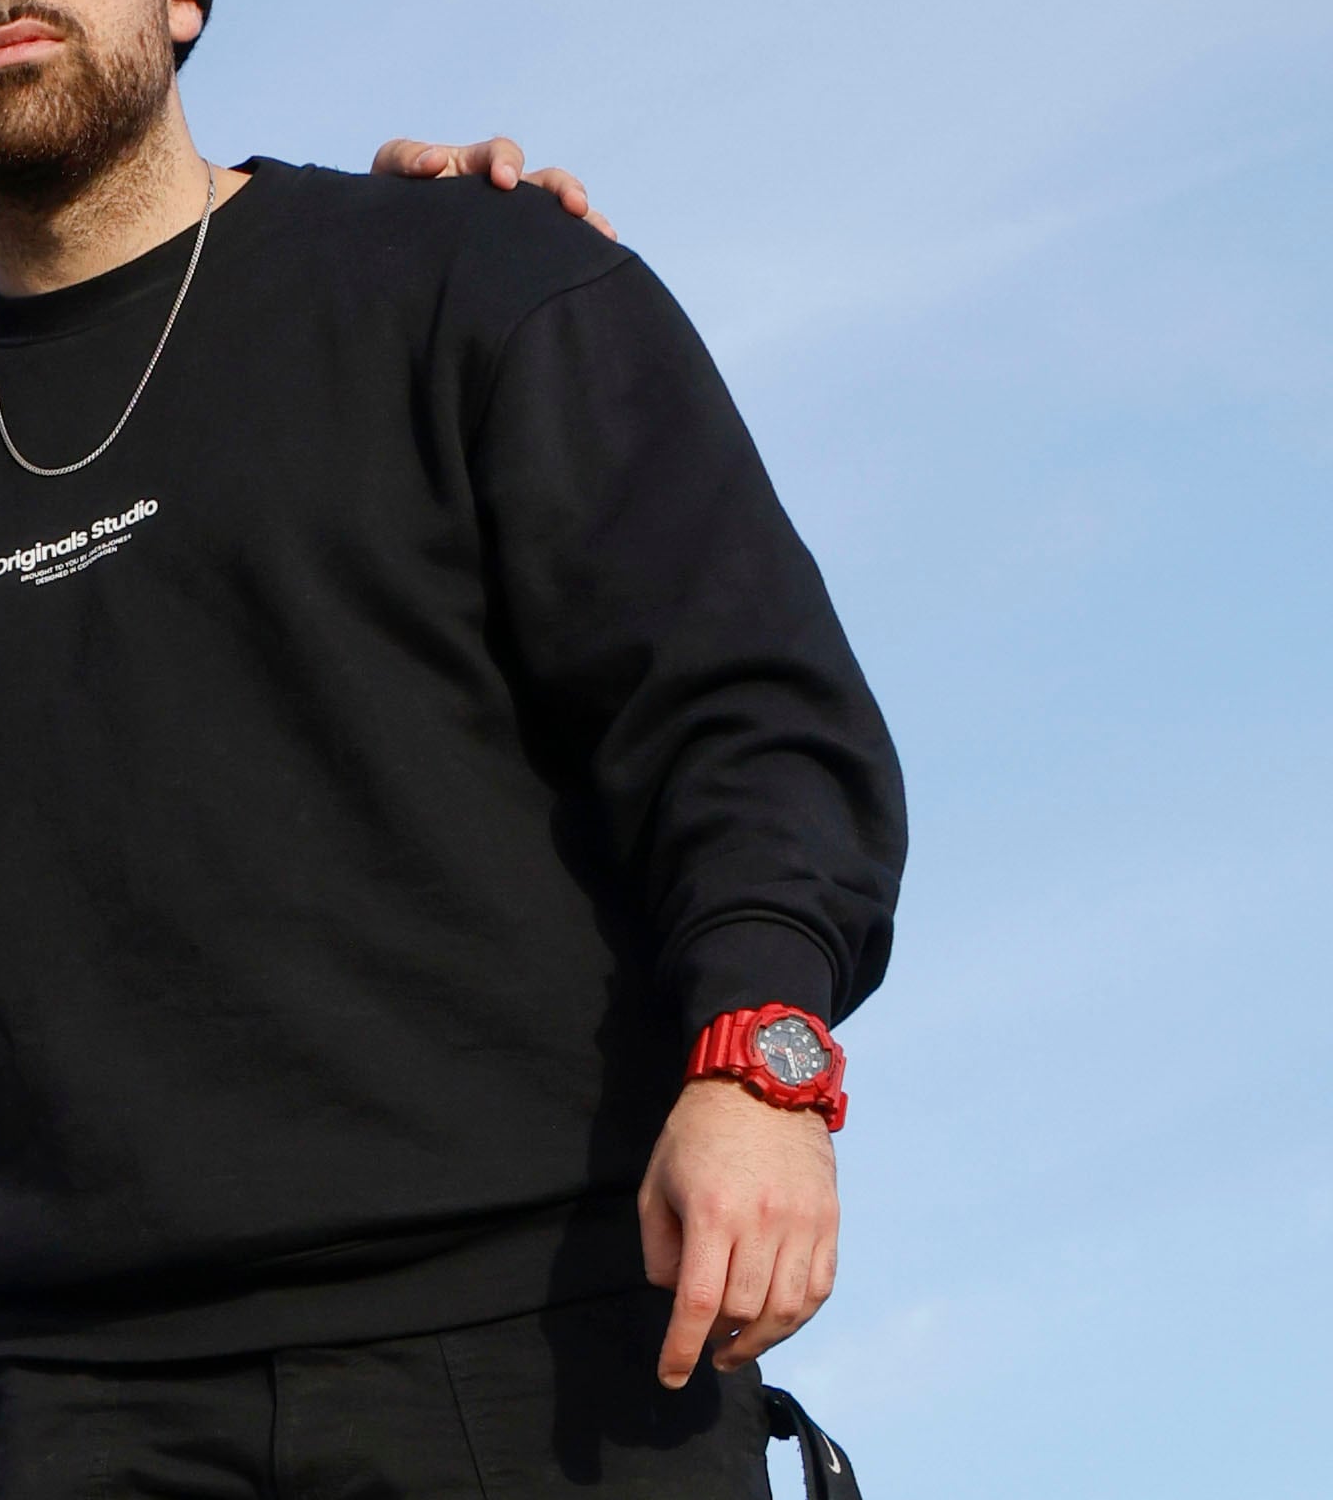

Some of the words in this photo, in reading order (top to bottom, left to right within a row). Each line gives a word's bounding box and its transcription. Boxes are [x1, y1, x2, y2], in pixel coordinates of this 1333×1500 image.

[91, 499, 159, 540] Studio
[54, 563, 64, 572] TO
[65, 557, 79, 568] YOU
